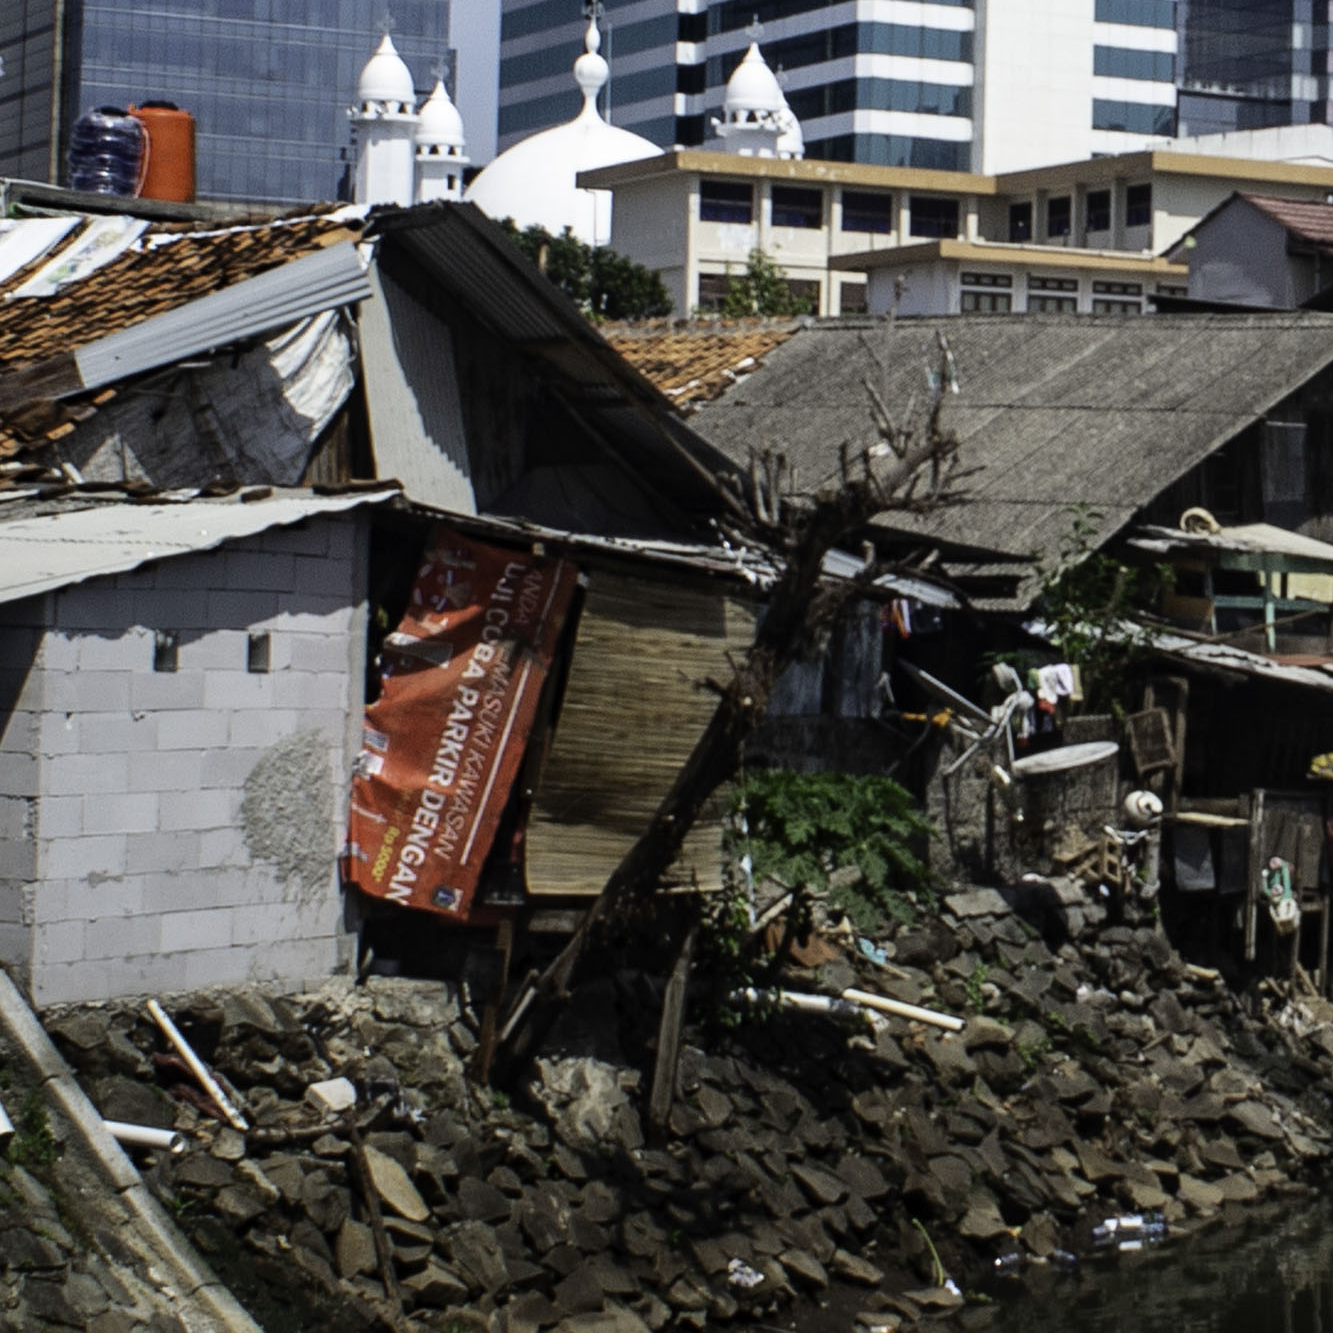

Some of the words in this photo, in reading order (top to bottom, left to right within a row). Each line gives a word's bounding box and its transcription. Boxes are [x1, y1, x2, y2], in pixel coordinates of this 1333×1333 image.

[490, 562, 527, 602] UJI
[512, 568, 545, 624] ANDA
[461, 607, 511, 678] COBA
[428, 684, 480, 787] PARKIR
[384, 788, 445, 906] DENGAN
[432, 748, 487, 862] KAWASAN
